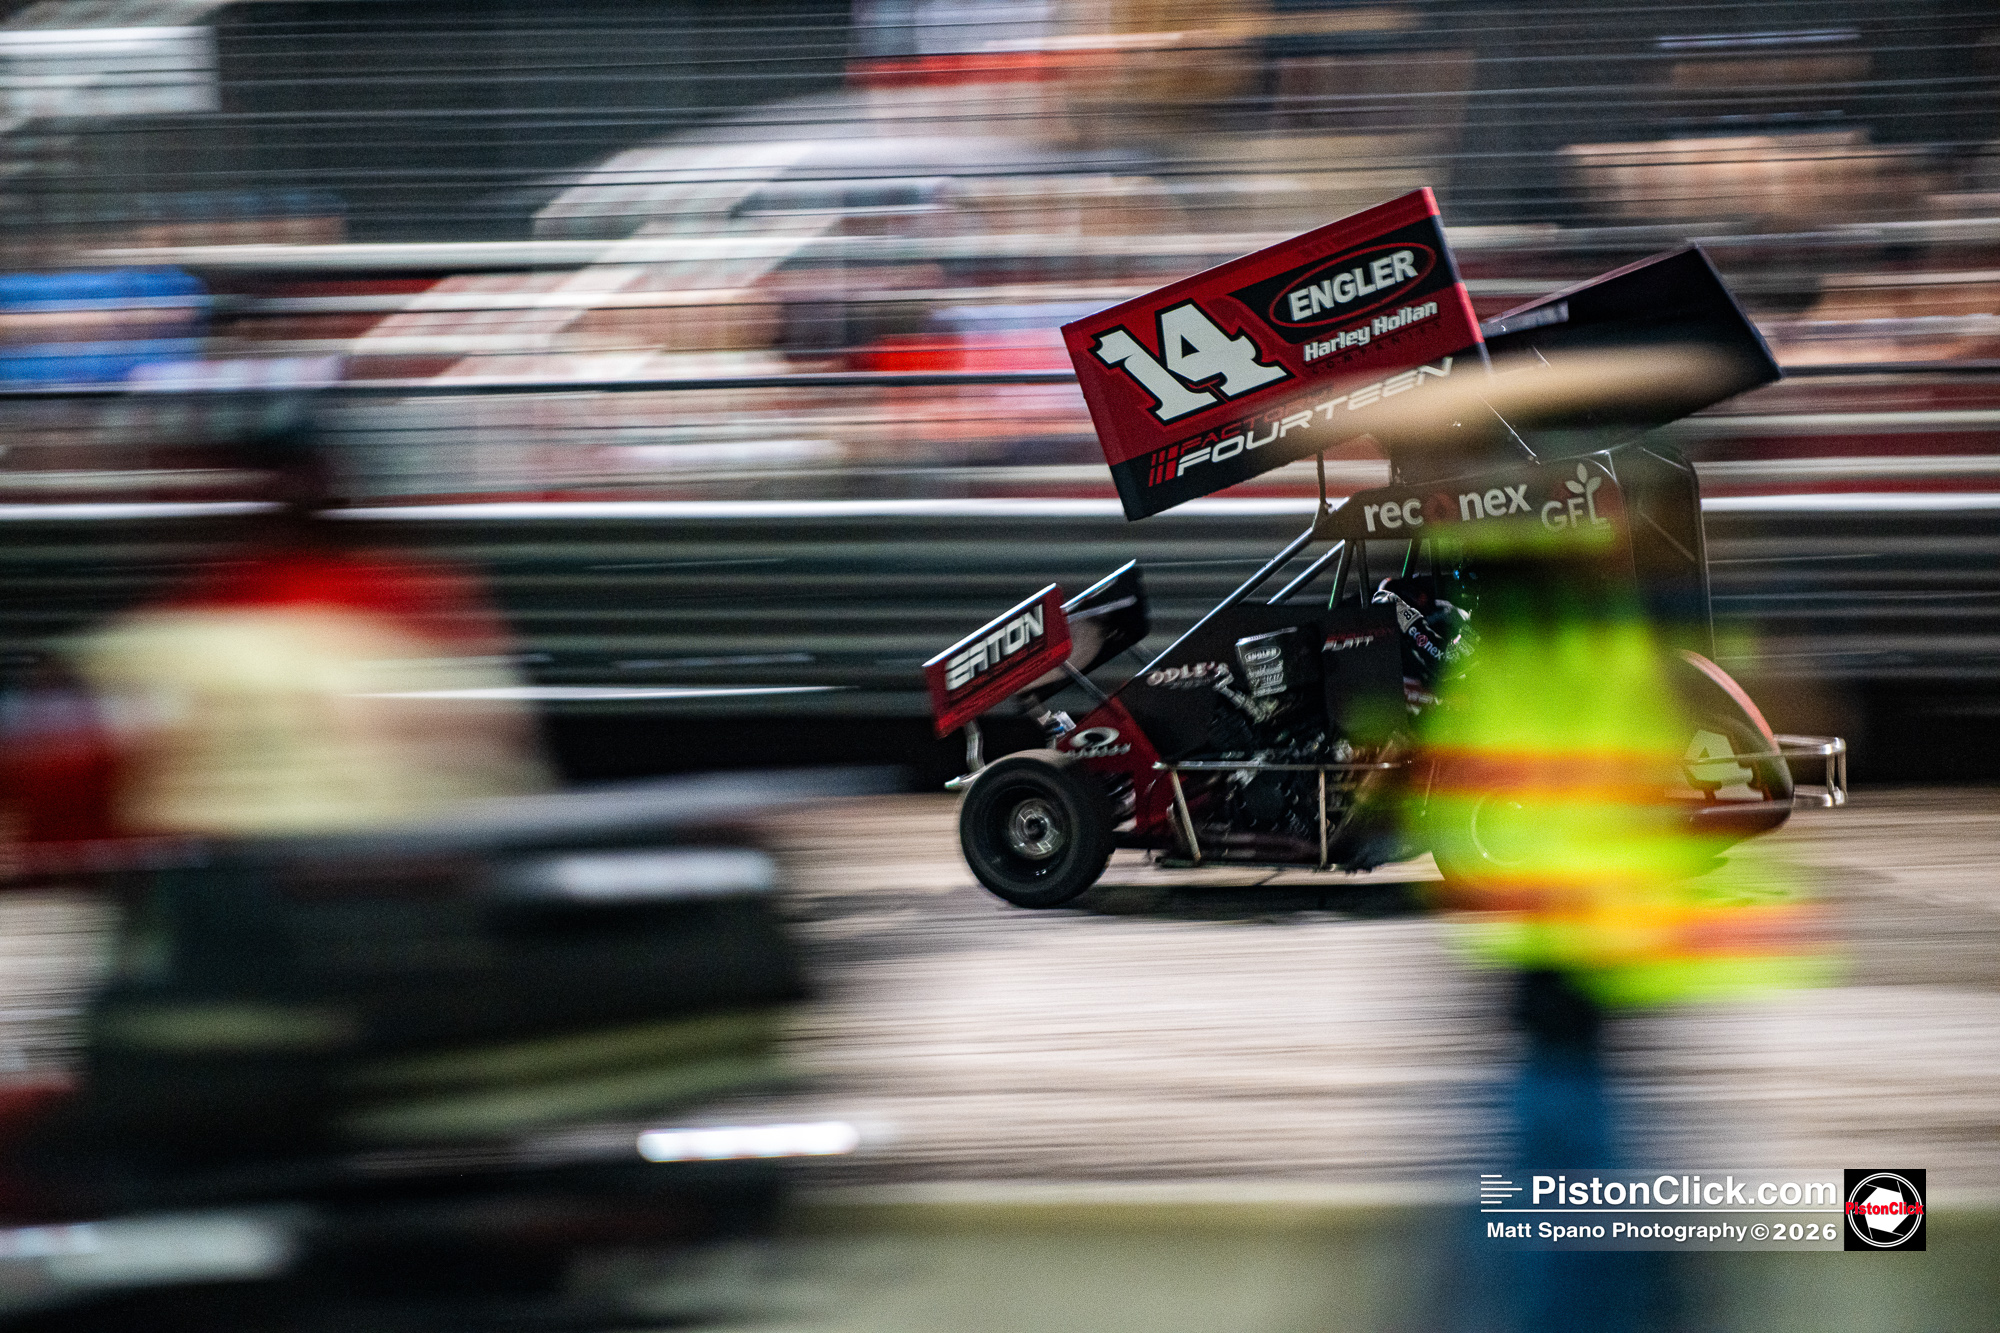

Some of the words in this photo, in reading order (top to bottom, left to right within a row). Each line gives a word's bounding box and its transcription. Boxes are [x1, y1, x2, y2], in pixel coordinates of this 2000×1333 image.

[1288, 249, 1419, 322] ENGLER
[1095, 302, 1290, 422] 14
[1303, 326, 1371, 362] Harley
[1371, 301, 1438, 336] Hollan
[1176, 356, 1454, 477] FOURTEEN
[945, 603, 1045, 691] EATON
[1664, 729, 1765, 801] 4
